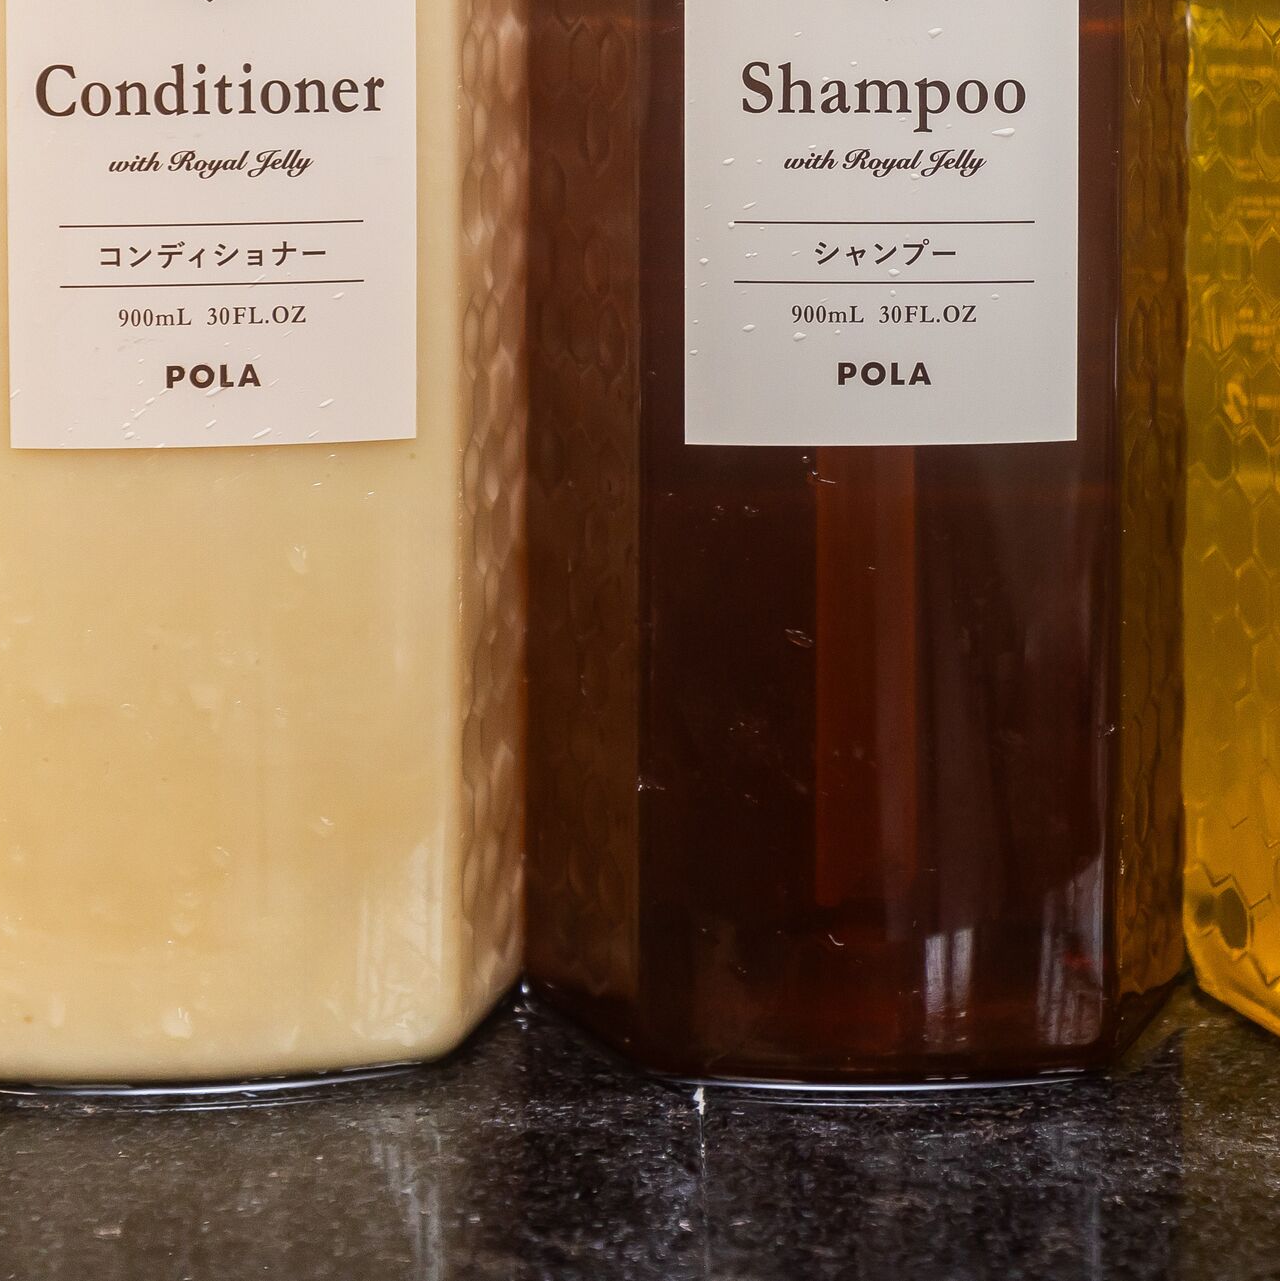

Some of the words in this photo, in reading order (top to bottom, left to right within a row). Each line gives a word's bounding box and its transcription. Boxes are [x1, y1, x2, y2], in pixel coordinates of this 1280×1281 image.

[35, 62, 385, 117] Conditioner
[741, 61, 1026, 133] Shampoo
[108, 151, 164, 173] with
[167, 150, 247, 180] Royal
[245, 149, 314, 178] Jelly
[783, 149, 839, 170] with
[842, 148, 922, 178] Royal
[919, 149, 987, 178] Jelly
[100, 240, 326, 269] コンディショナー
[814, 238, 957, 267] シャンプー
[118, 307, 192, 328] 900mL
[206, 305, 306, 326] 30FL.OZ
[791, 305, 865, 324] 900mL
[878, 304, 977, 324] 30FL.OZ
[166, 363, 262, 389] POLA
[837, 361, 932, 386] POLA
